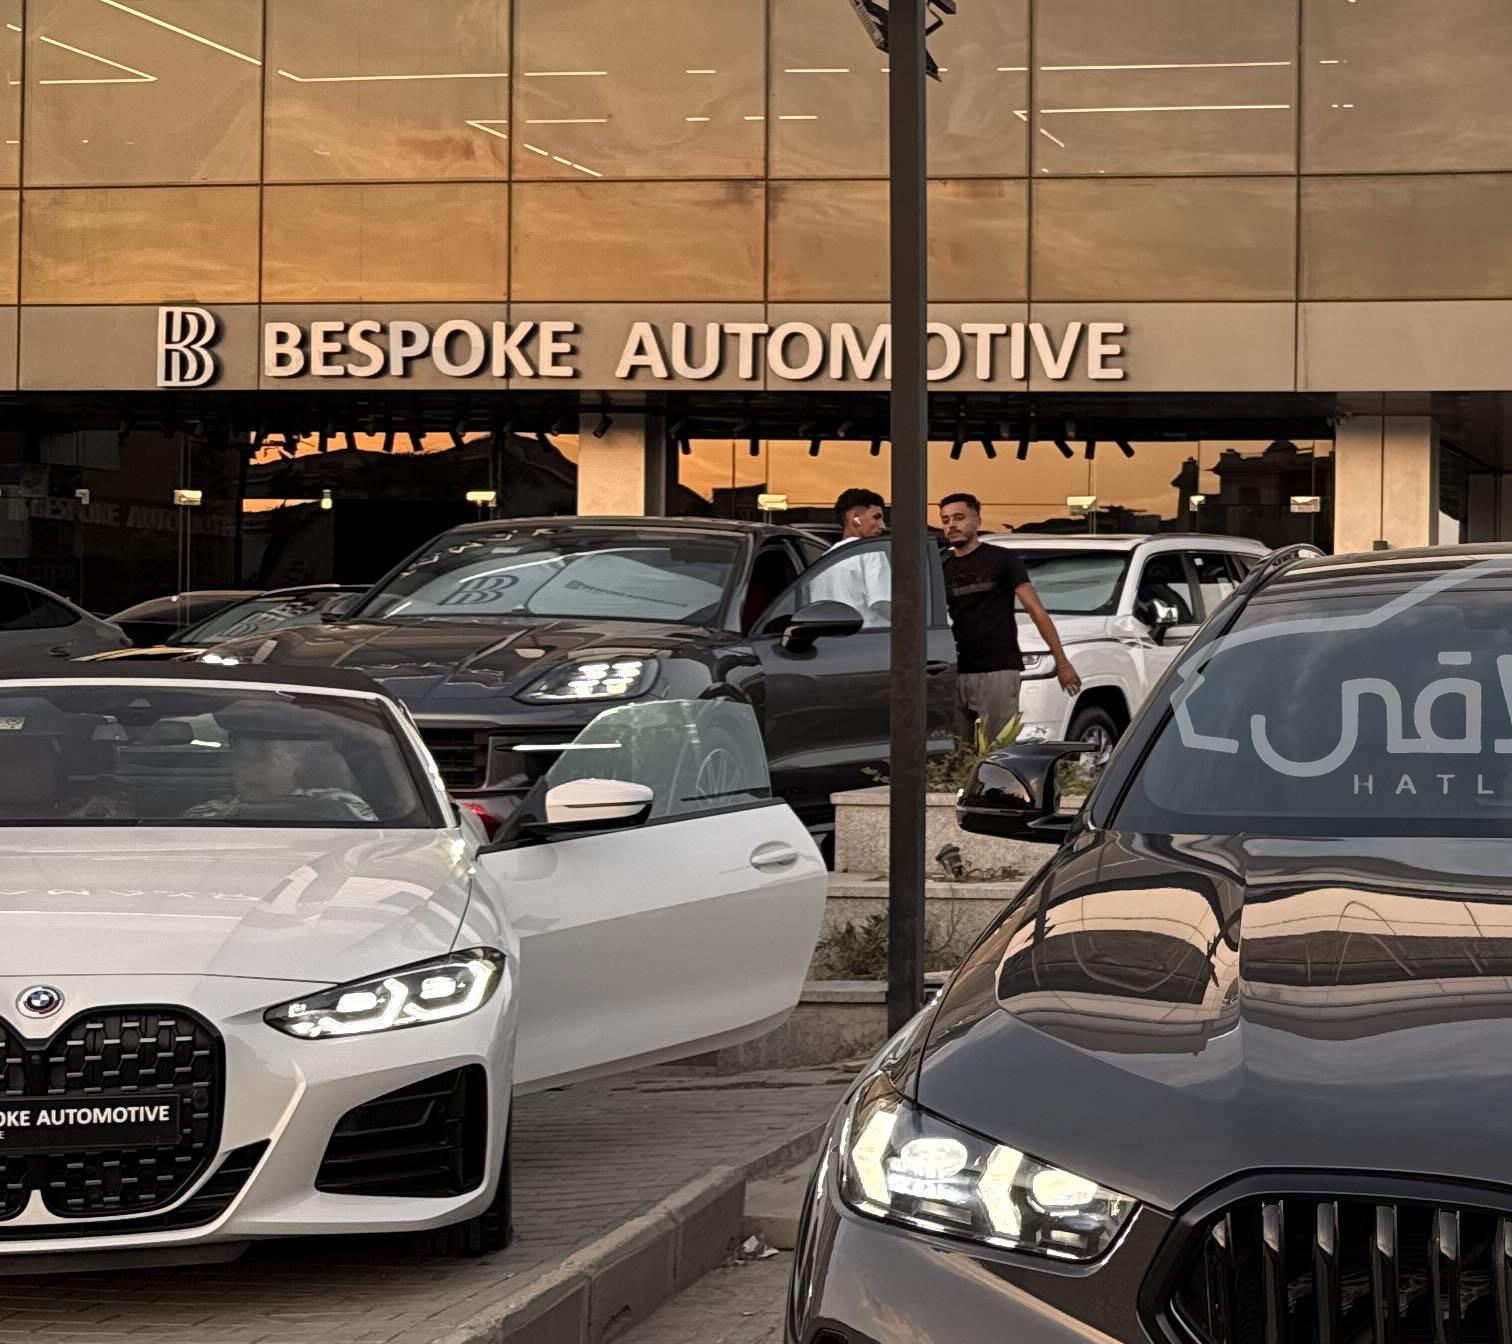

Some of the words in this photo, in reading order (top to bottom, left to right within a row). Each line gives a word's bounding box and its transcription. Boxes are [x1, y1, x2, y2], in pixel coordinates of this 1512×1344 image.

[264, 319, 576, 378] BESPOKE
[615, 320, 1125, 380] AUTOMOTIVE
[36, 1105, 170, 1126] AUTOMOTIVE
